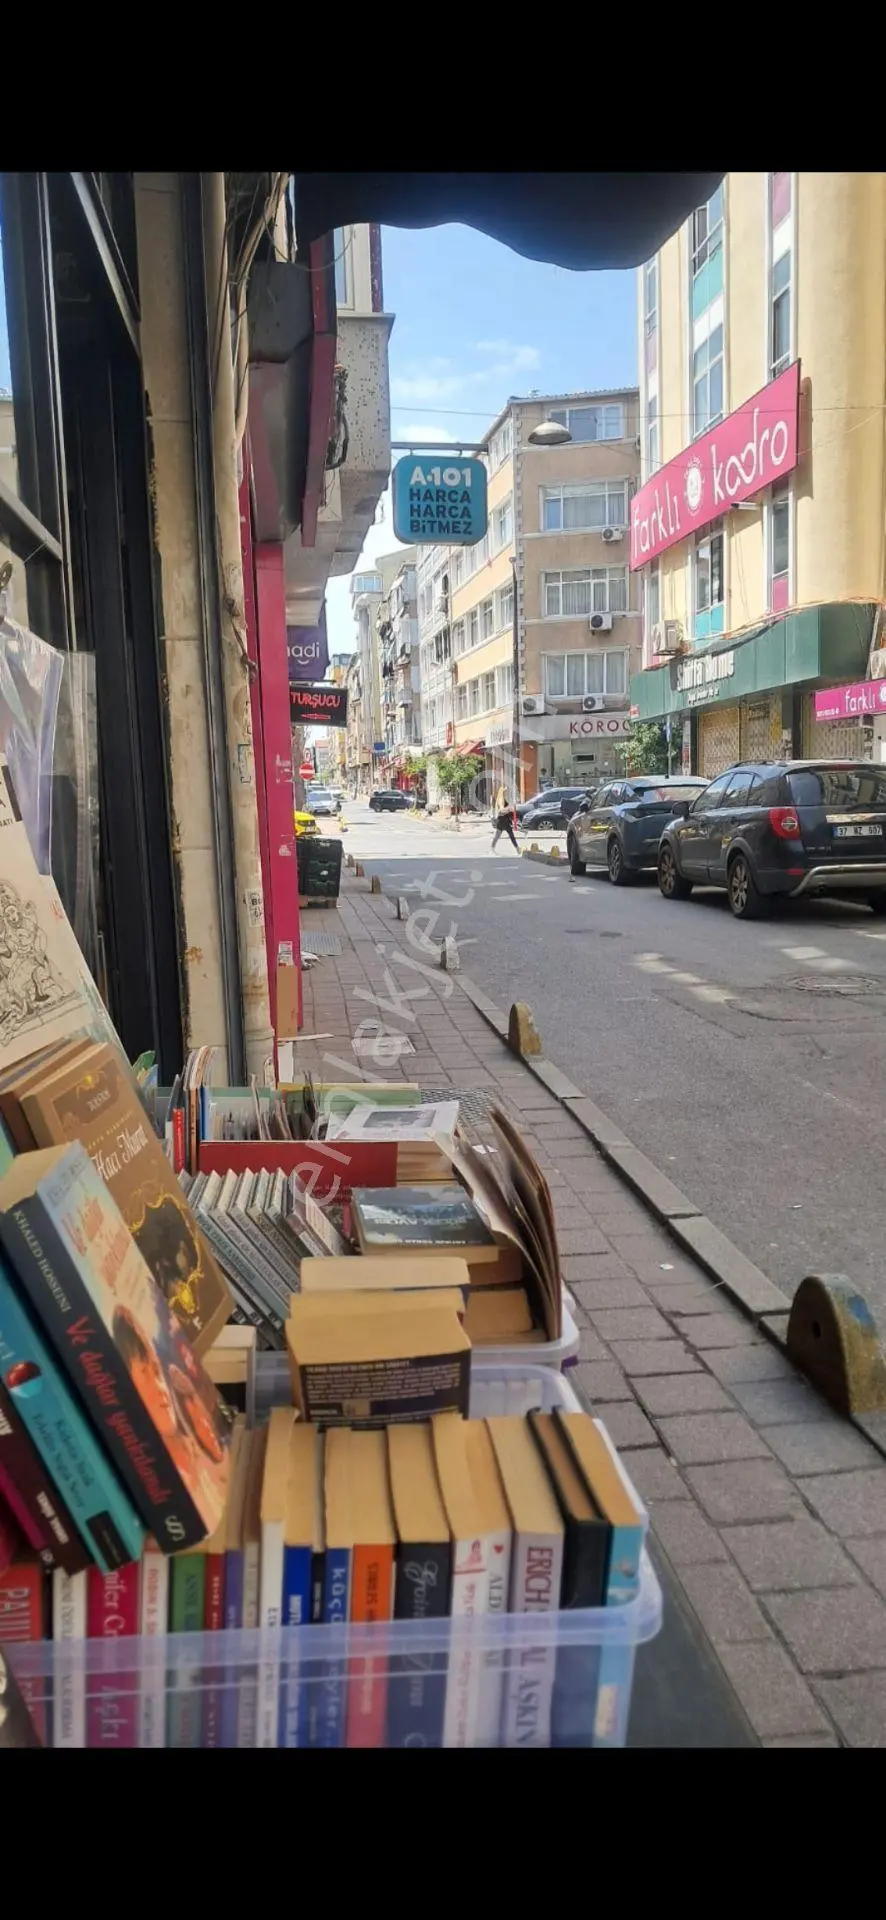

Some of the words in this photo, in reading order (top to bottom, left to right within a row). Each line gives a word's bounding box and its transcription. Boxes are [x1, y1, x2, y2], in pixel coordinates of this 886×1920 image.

[409, 487, 472, 504] HARCA
[409, 504, 472, 519] HARCA
[290, 692, 341, 709] TURŞUCU
[12, 1210, 44, 1258] KHALED
[66, 1315, 96, 1346] Ve
[525, 1546, 554, 1605] ERICH
[327, 1567, 346, 1627] küçü
